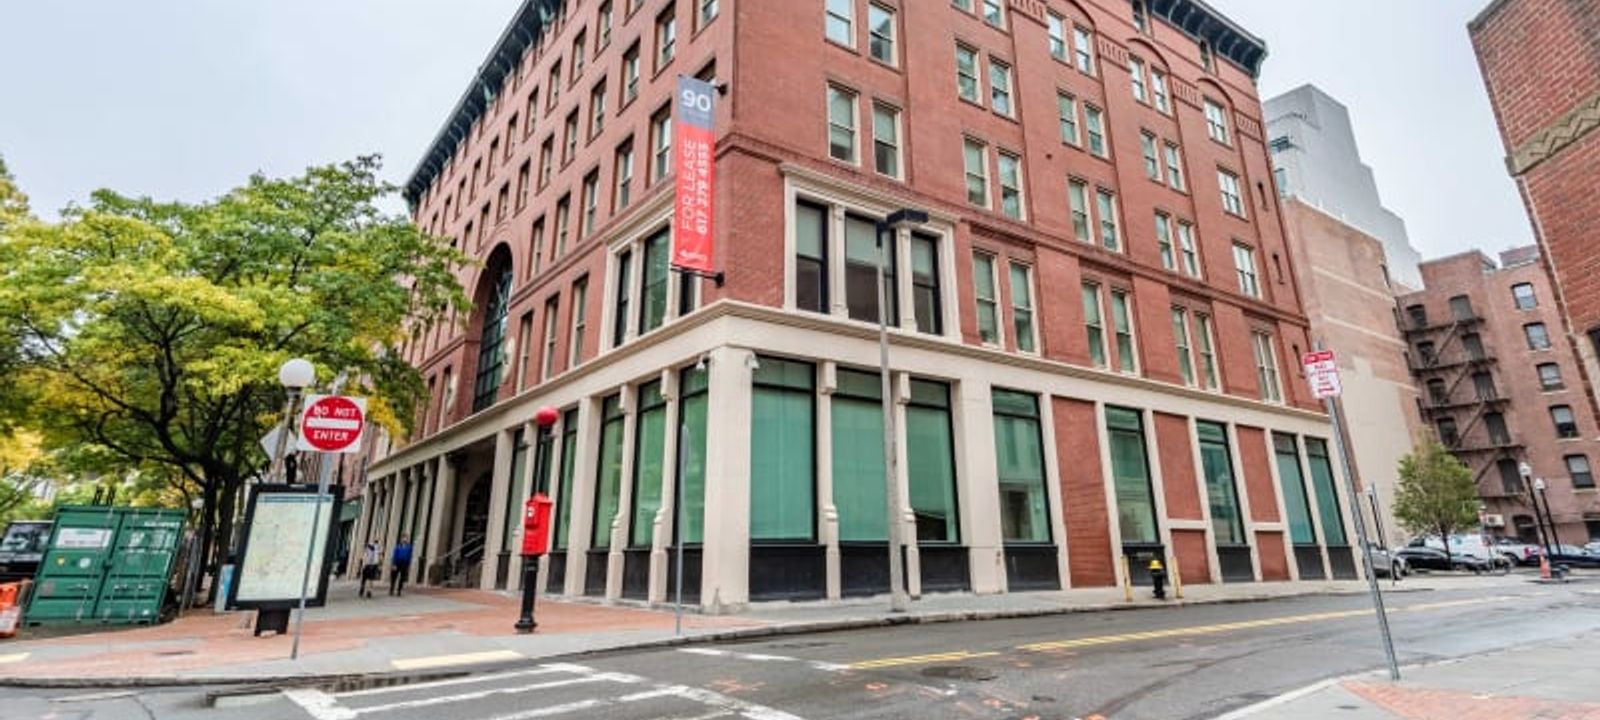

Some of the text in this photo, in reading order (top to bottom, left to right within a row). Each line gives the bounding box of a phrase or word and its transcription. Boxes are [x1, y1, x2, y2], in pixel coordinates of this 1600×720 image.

[680, 89, 711, 112] 90
[681, 138, 697, 231] FOR LEASE
[695, 209, 708, 235] 617
[313, 405, 357, 417] DO NOT
[313, 430, 349, 441] ENTER
